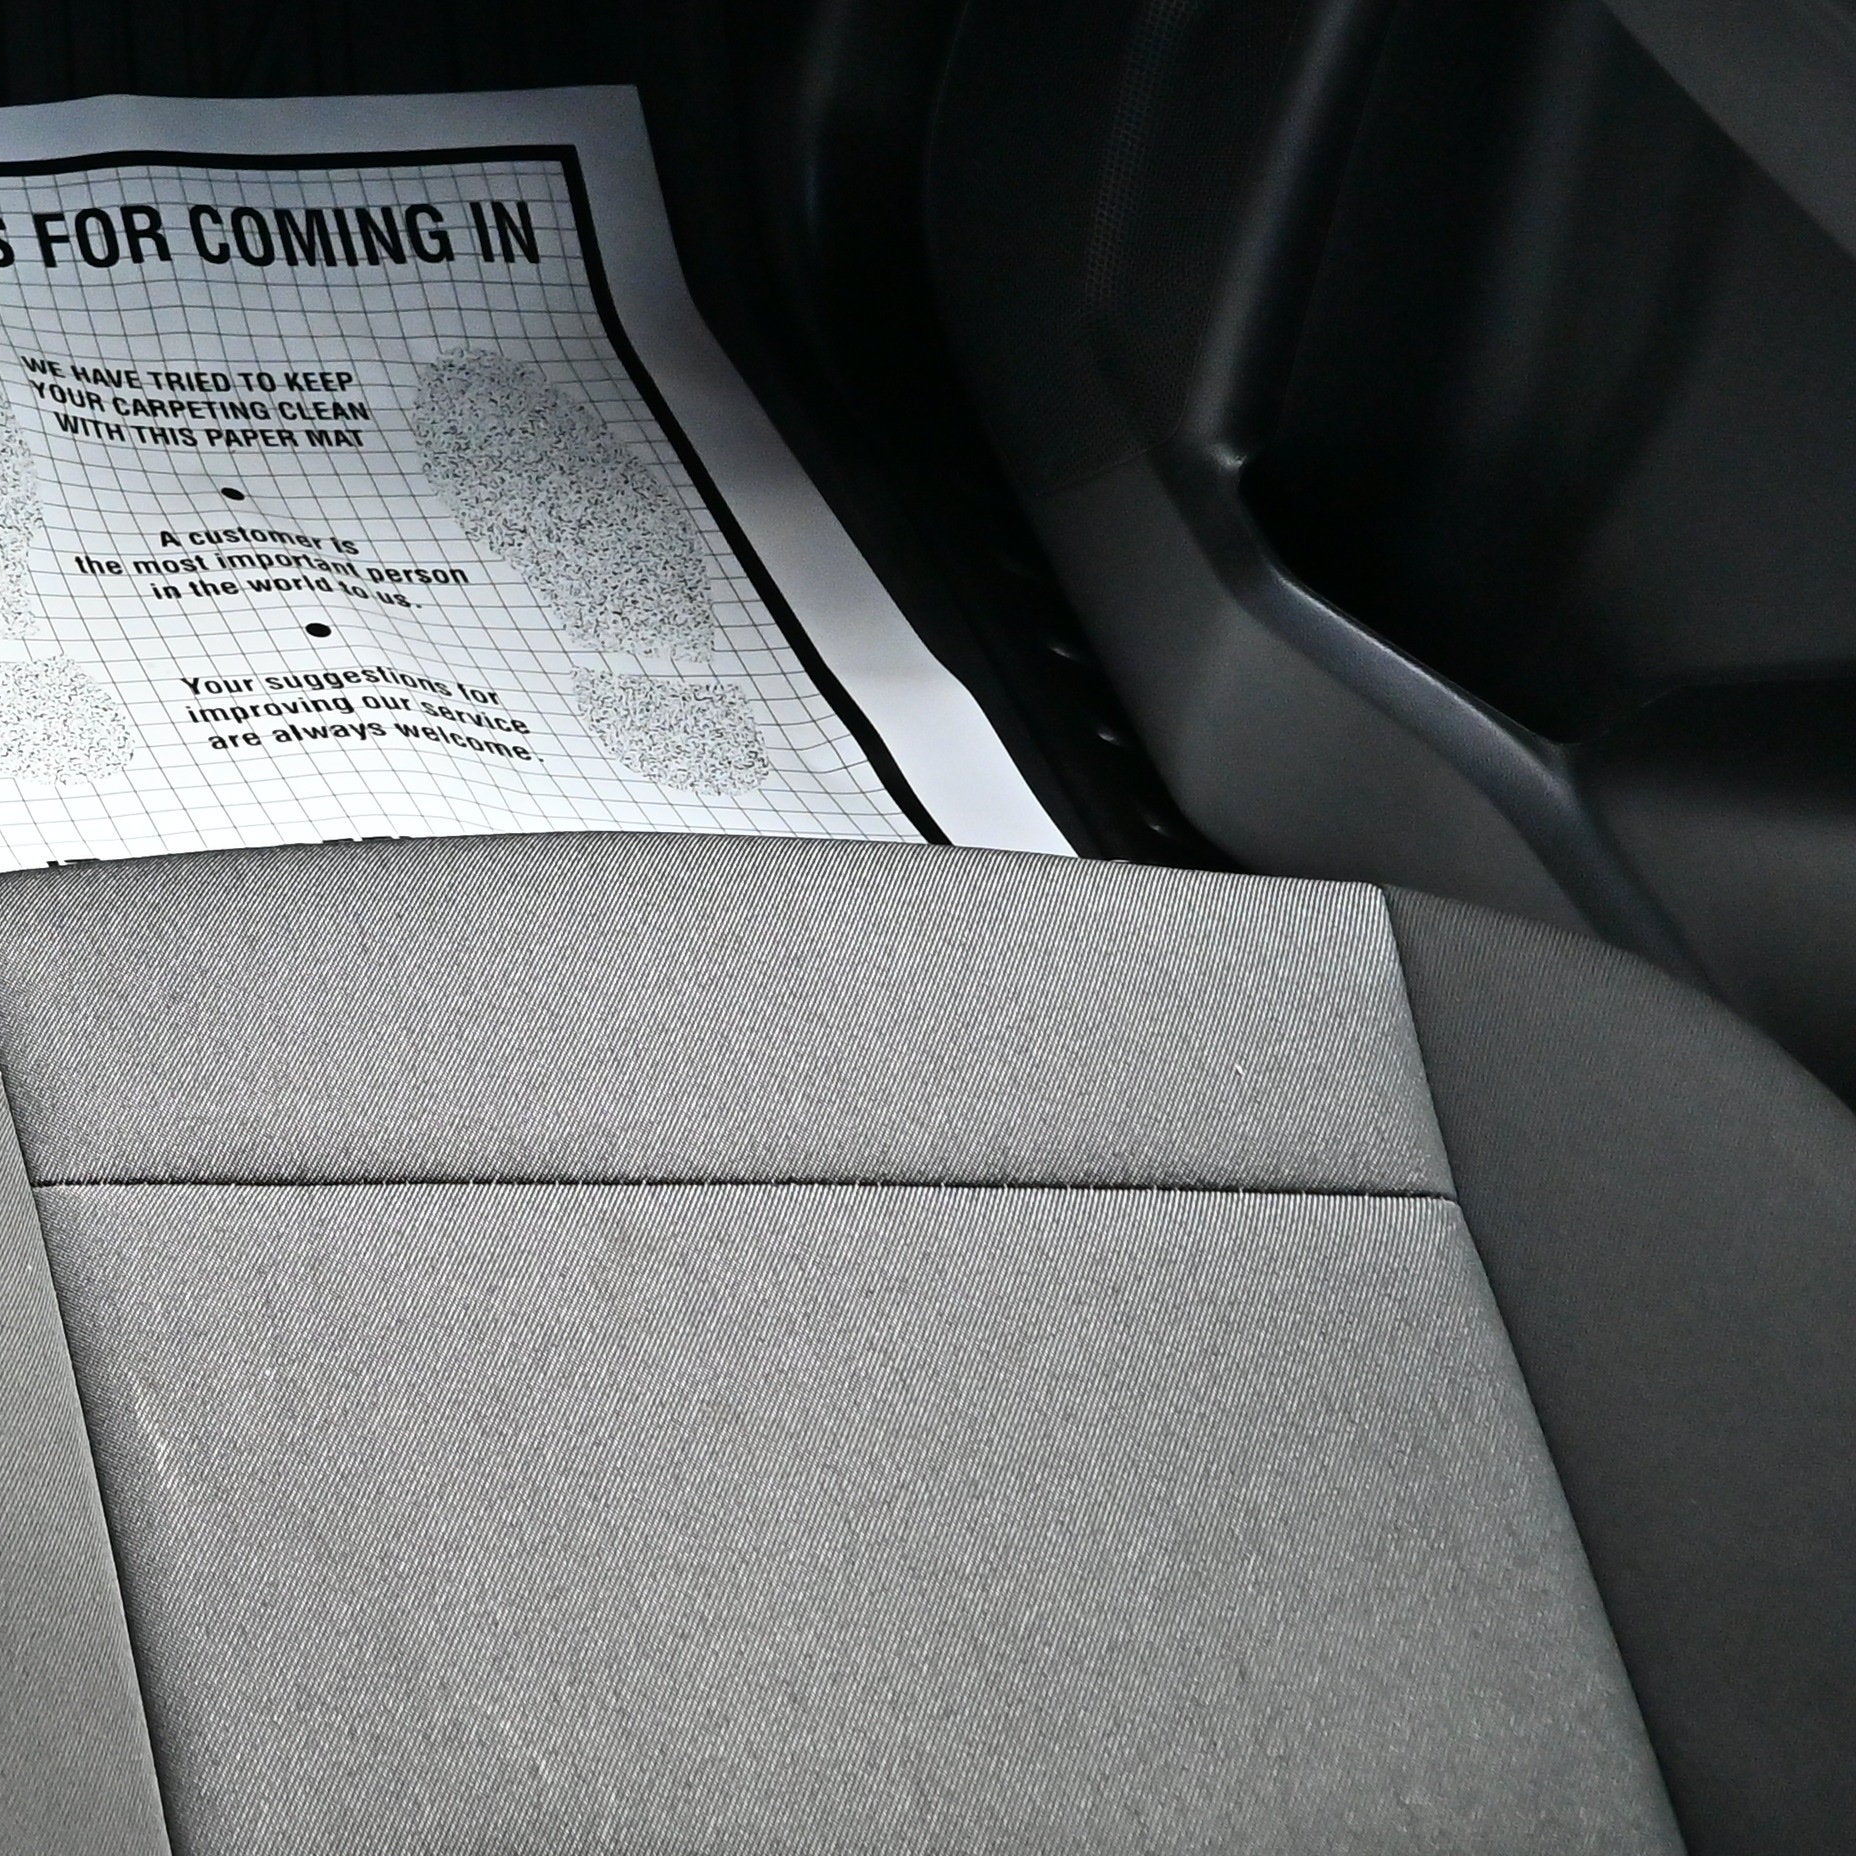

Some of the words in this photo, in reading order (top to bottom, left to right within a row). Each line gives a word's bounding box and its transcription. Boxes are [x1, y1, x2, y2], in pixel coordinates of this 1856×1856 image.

[32, 204, 172, 269] FOR
[190, 202, 456, 269] COMING
[471, 200, 542, 265] IN
[20, 355, 66, 378] WE
[71, 365, 140, 389] HAVE
[147, 371, 231, 393] TRIED
[238, 372, 277, 392] TO
[284, 371, 354, 392] KEEP
[30, 379, 105, 412] YOUR
[112, 397, 271, 421] CARPETING
[278, 401, 370, 421] CLEAN
[54, 411, 125, 441] WITH
[135, 425, 198, 446] THIS
[205, 428, 296, 447] PAPER
[305, 429, 364, 448] MAT
[159, 530, 180, 547] A
[188, 527, 323, 550] customer
[331, 536, 360, 556] is
[75, 554, 122, 575] the
[133, 554, 208, 575] most
[218, 553, 361, 578] important
[366, 566, 470, 586] person
[150, 582, 182, 600] in
[189, 579, 239, 598] the
[246, 574, 333, 594] world
[338, 580, 370, 599] to
[375, 591, 422, 609] us.
[181, 677, 254, 695] Your
[264, 666, 453, 697] suggestions
[456, 682, 500, 706] for
[186, 695, 354, 724] improving
[361, 695, 412, 711] our
[419, 702, 531, 735] service
[208, 732, 260, 750] are
[272, 719, 387, 743] always
[393, 720, 545, 763] welcome.
